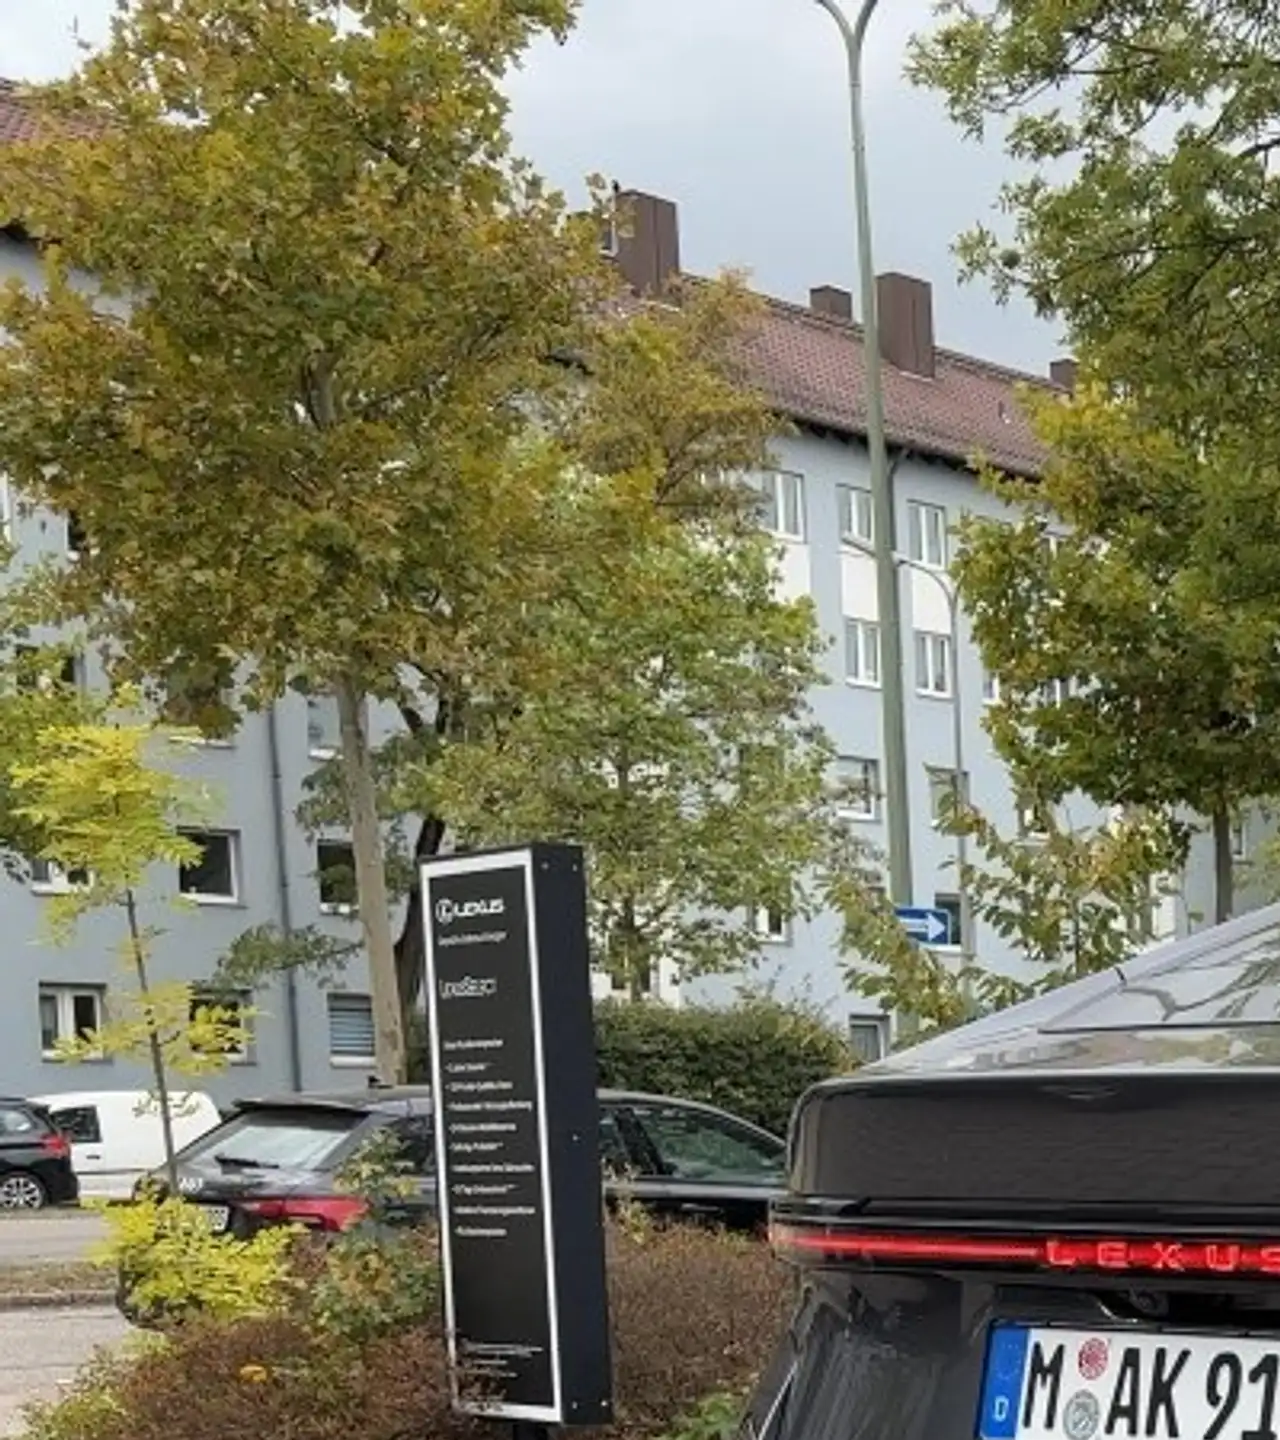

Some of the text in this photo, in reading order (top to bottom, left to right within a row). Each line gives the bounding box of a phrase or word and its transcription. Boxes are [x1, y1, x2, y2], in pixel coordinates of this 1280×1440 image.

[992, 1395, 1007, 1423] D
[1022, 1341, 1066, 1431] M
[1104, 1346, 1192, 1440] AK
